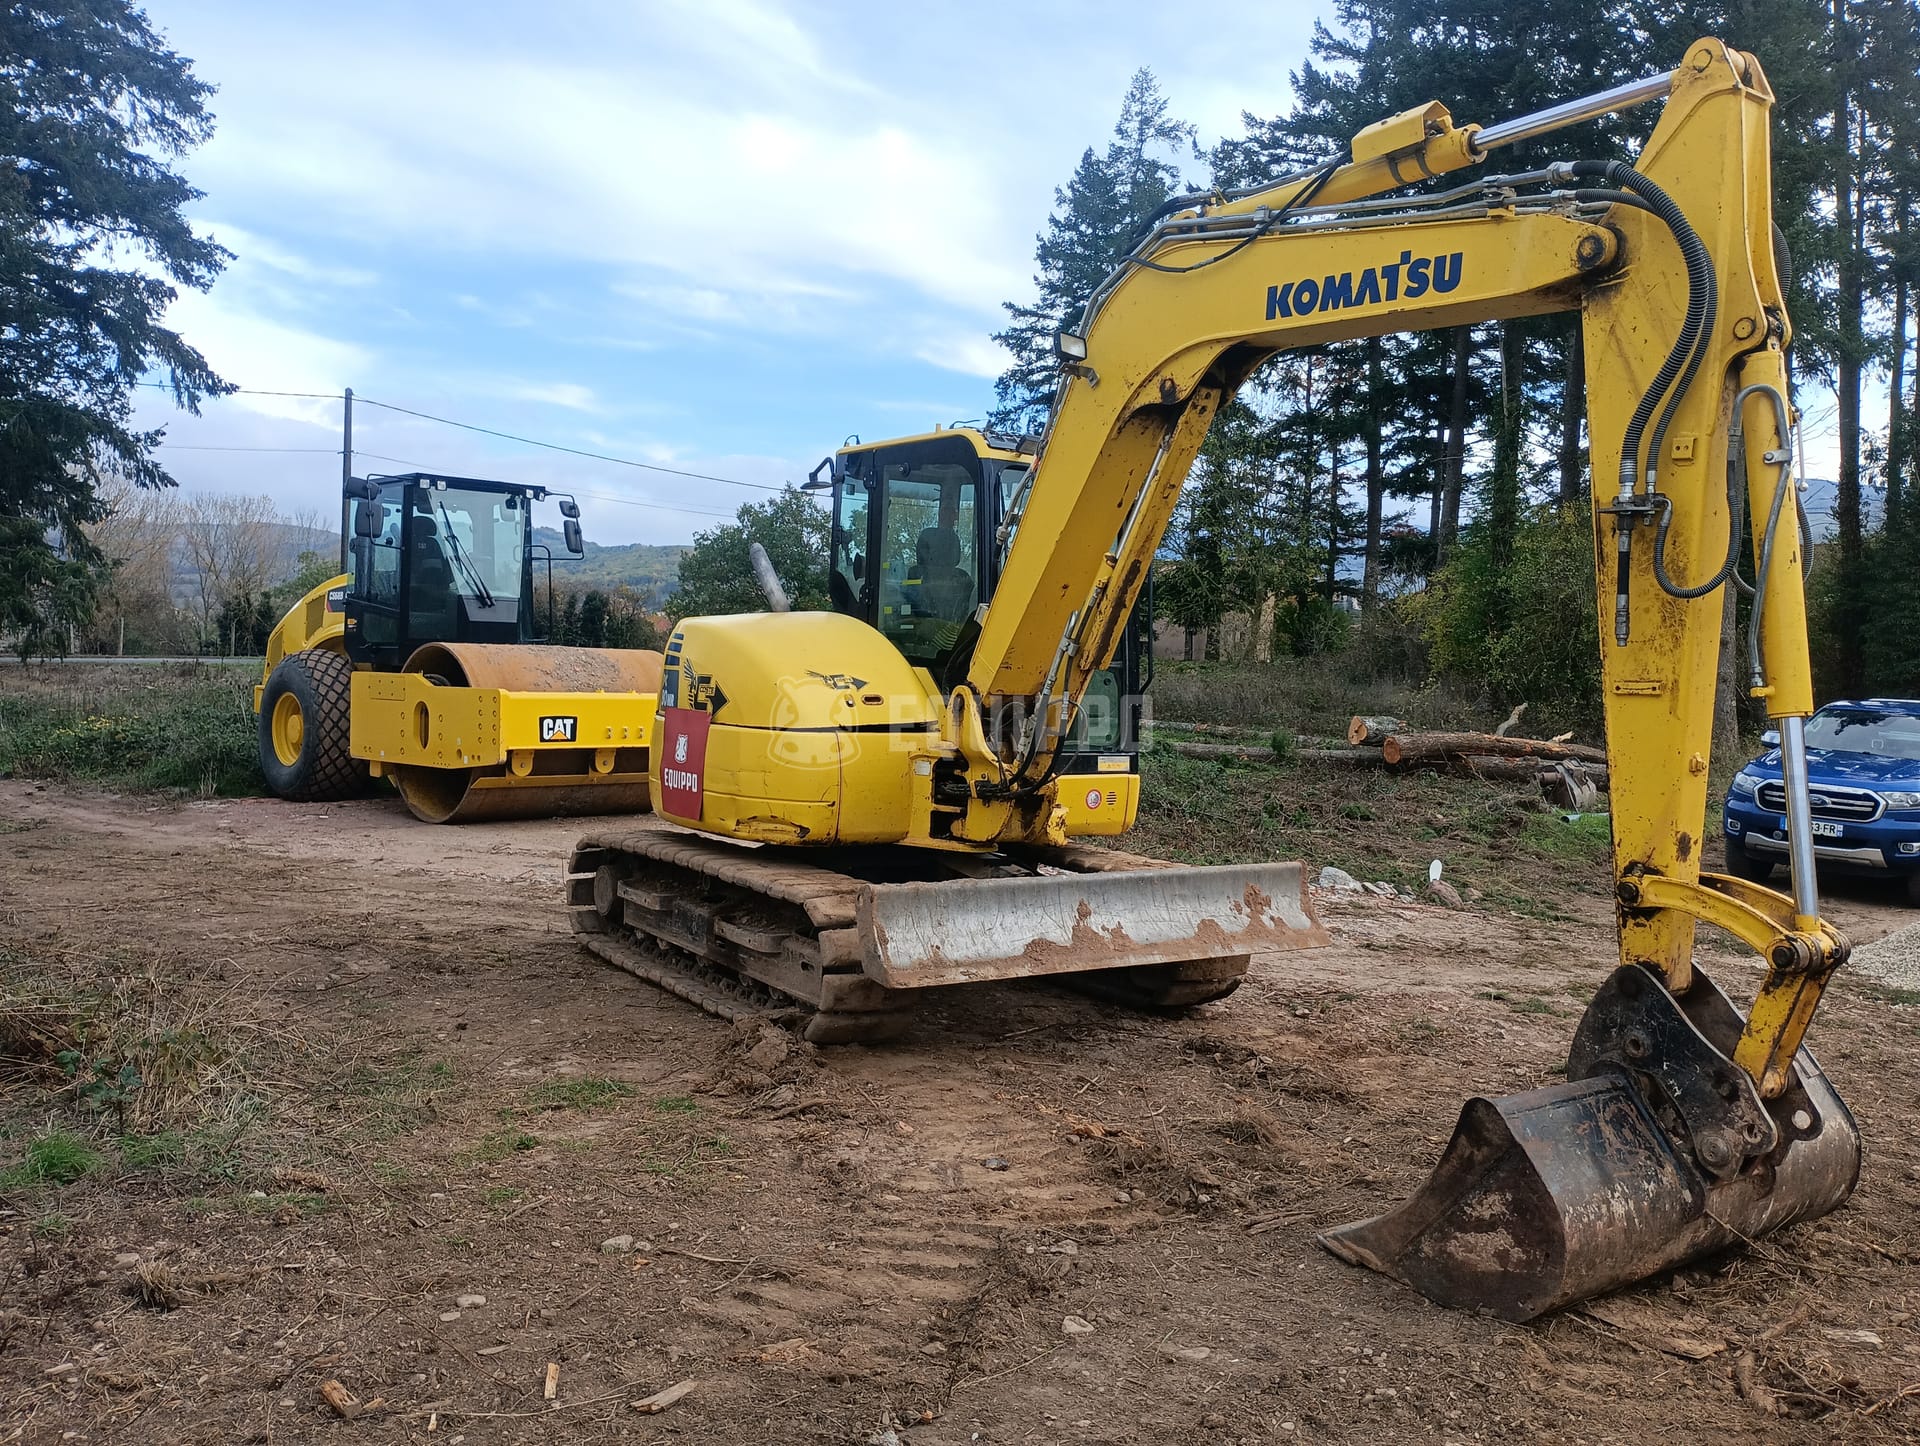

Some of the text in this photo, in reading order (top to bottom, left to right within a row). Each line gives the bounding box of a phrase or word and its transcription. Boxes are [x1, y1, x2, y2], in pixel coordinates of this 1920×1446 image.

[1265, 249, 1463, 321] KOMATSU
[543, 718, 573, 740] CAT
[664, 768, 698, 793] EQUIPPO
